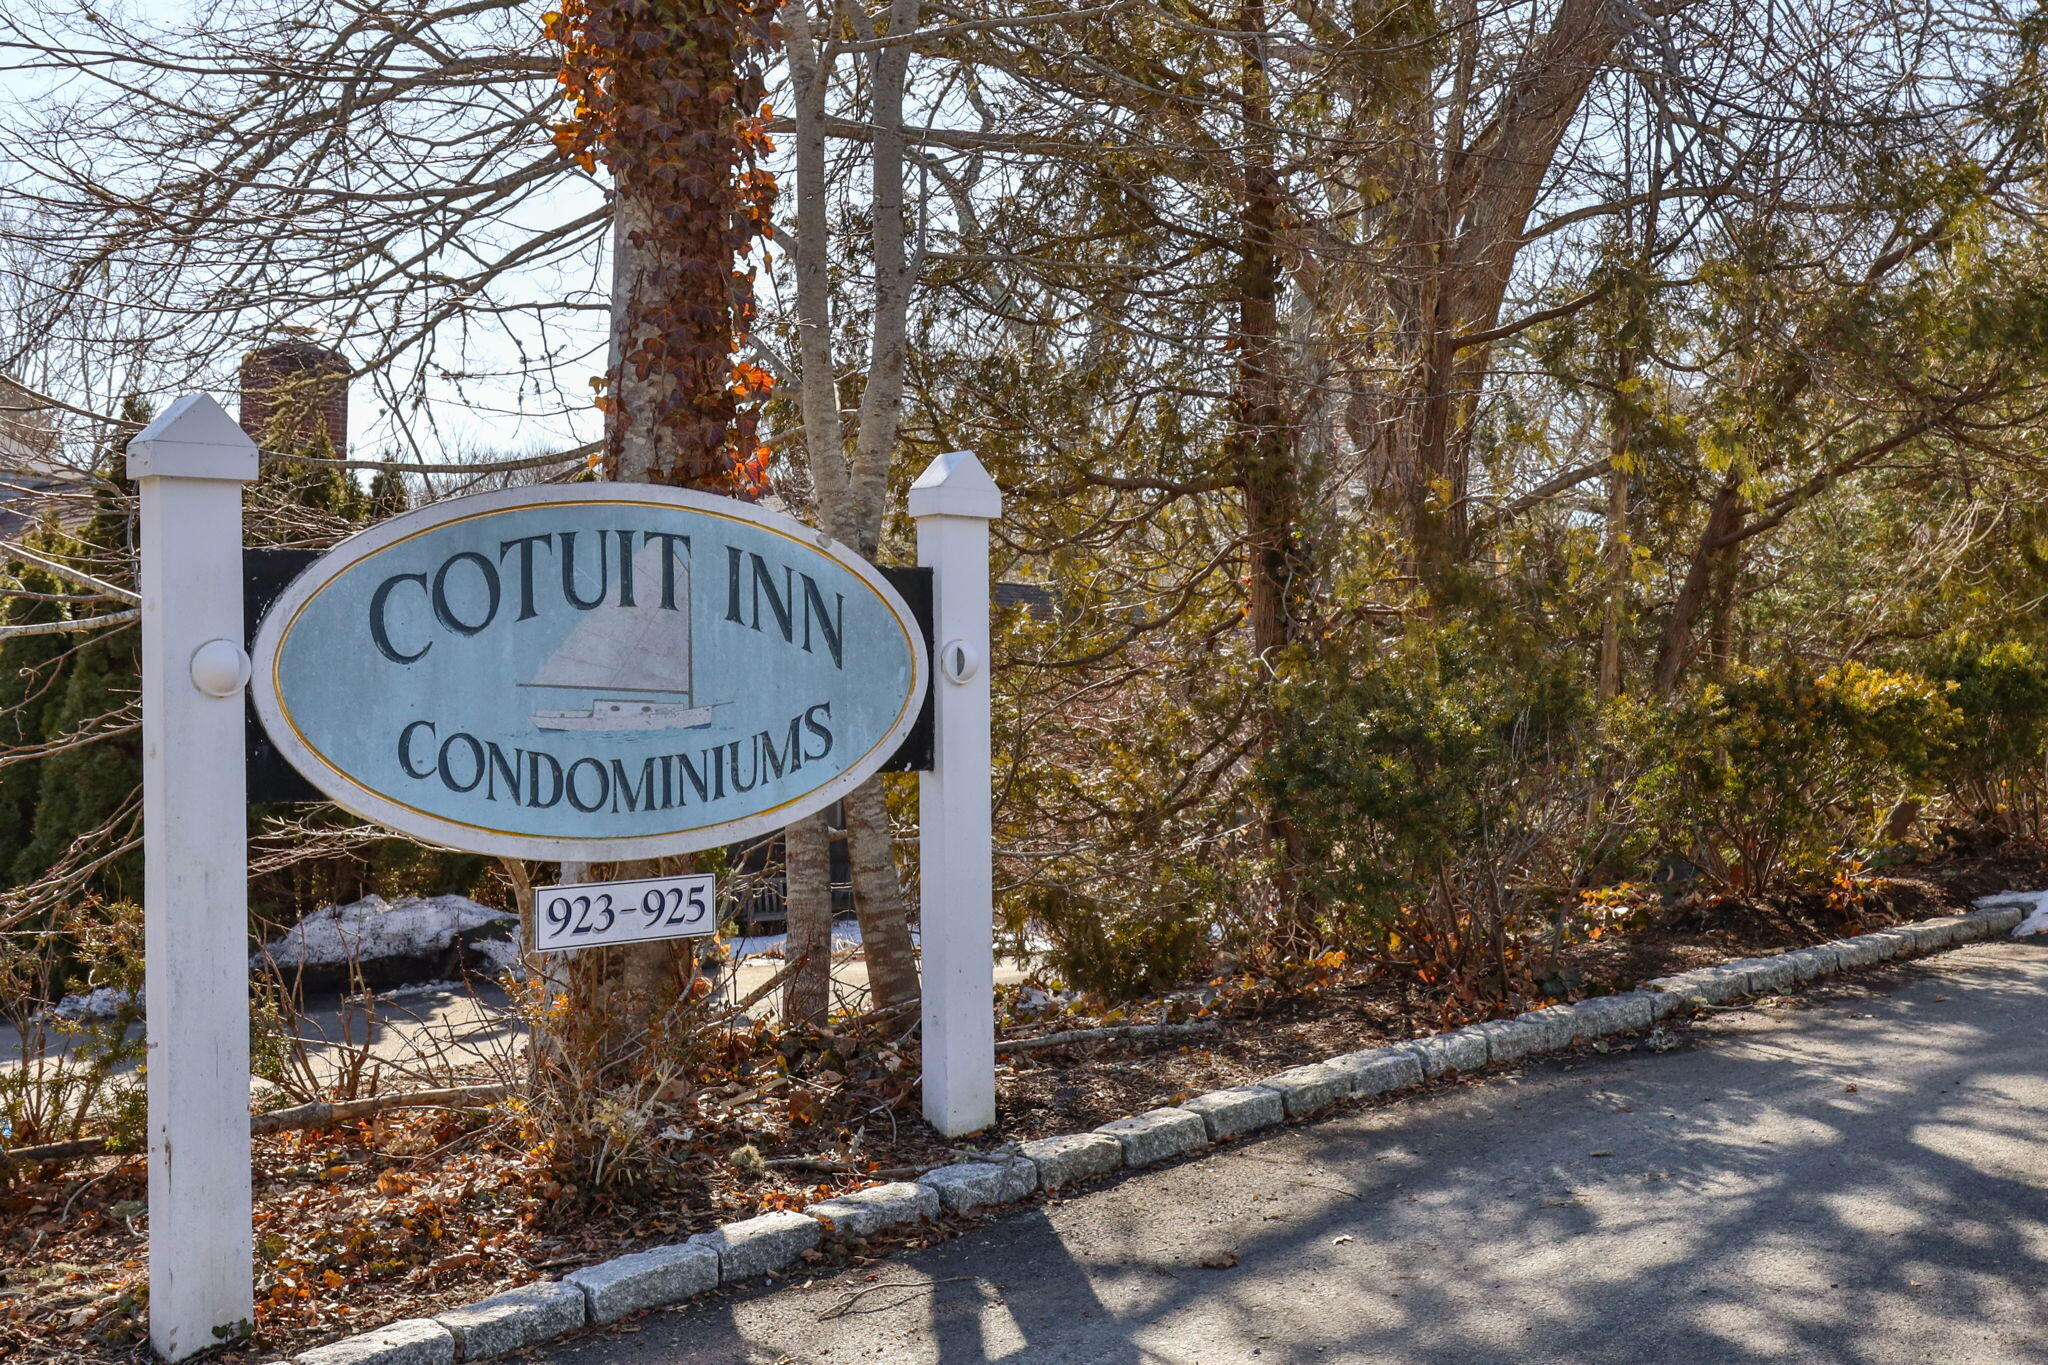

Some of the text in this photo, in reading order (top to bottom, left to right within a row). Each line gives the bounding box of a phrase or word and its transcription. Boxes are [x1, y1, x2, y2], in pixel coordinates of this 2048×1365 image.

[369, 529, 845, 671] COTUIT INN
[398, 701, 834, 813] CONDOMINIUMS
[547, 884, 706, 939] 923-925
